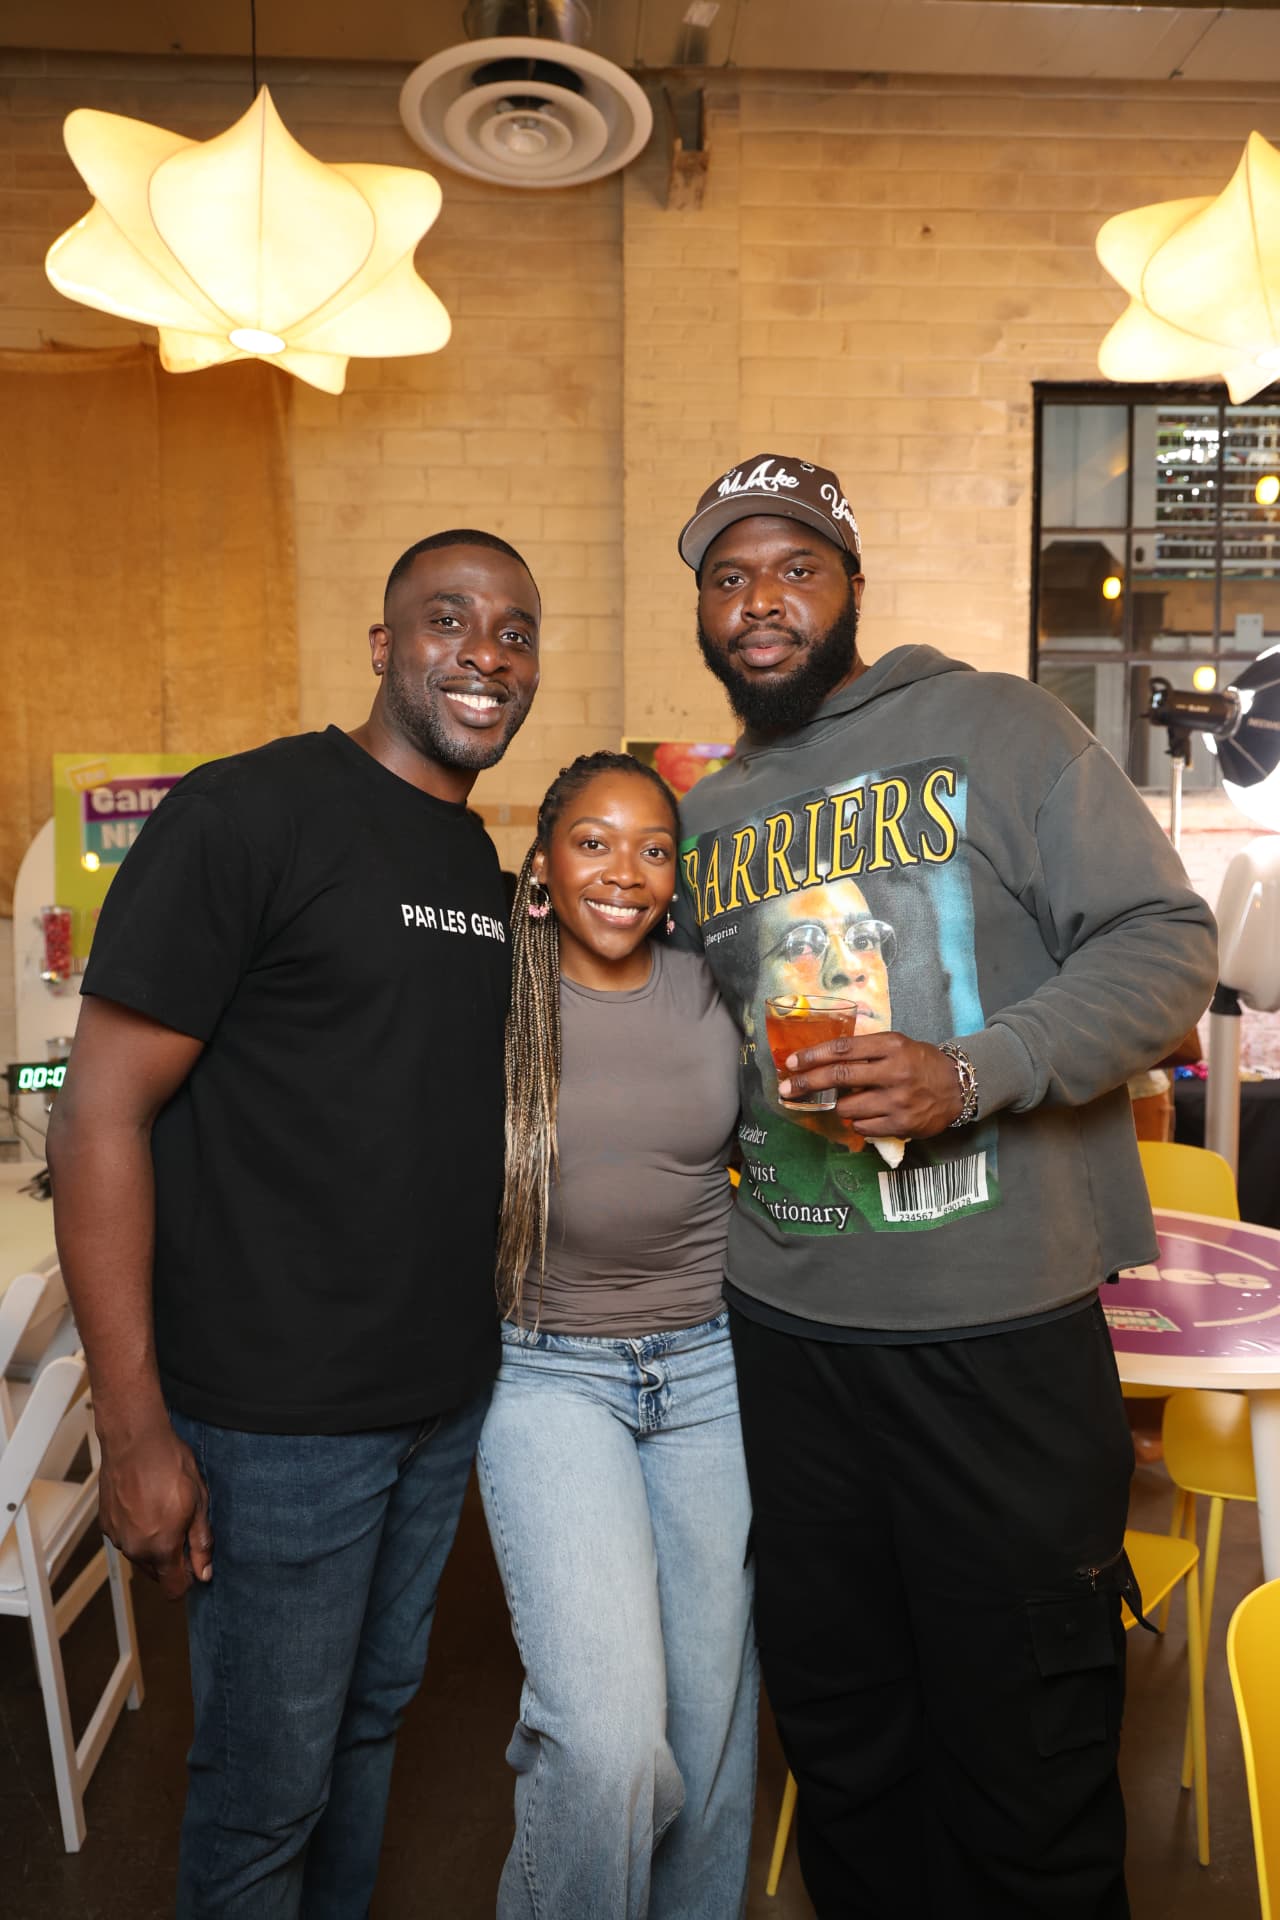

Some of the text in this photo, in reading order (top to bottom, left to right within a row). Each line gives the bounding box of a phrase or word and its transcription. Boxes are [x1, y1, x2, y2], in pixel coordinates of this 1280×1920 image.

[401, 904, 505, 943] PAR LES GENS
